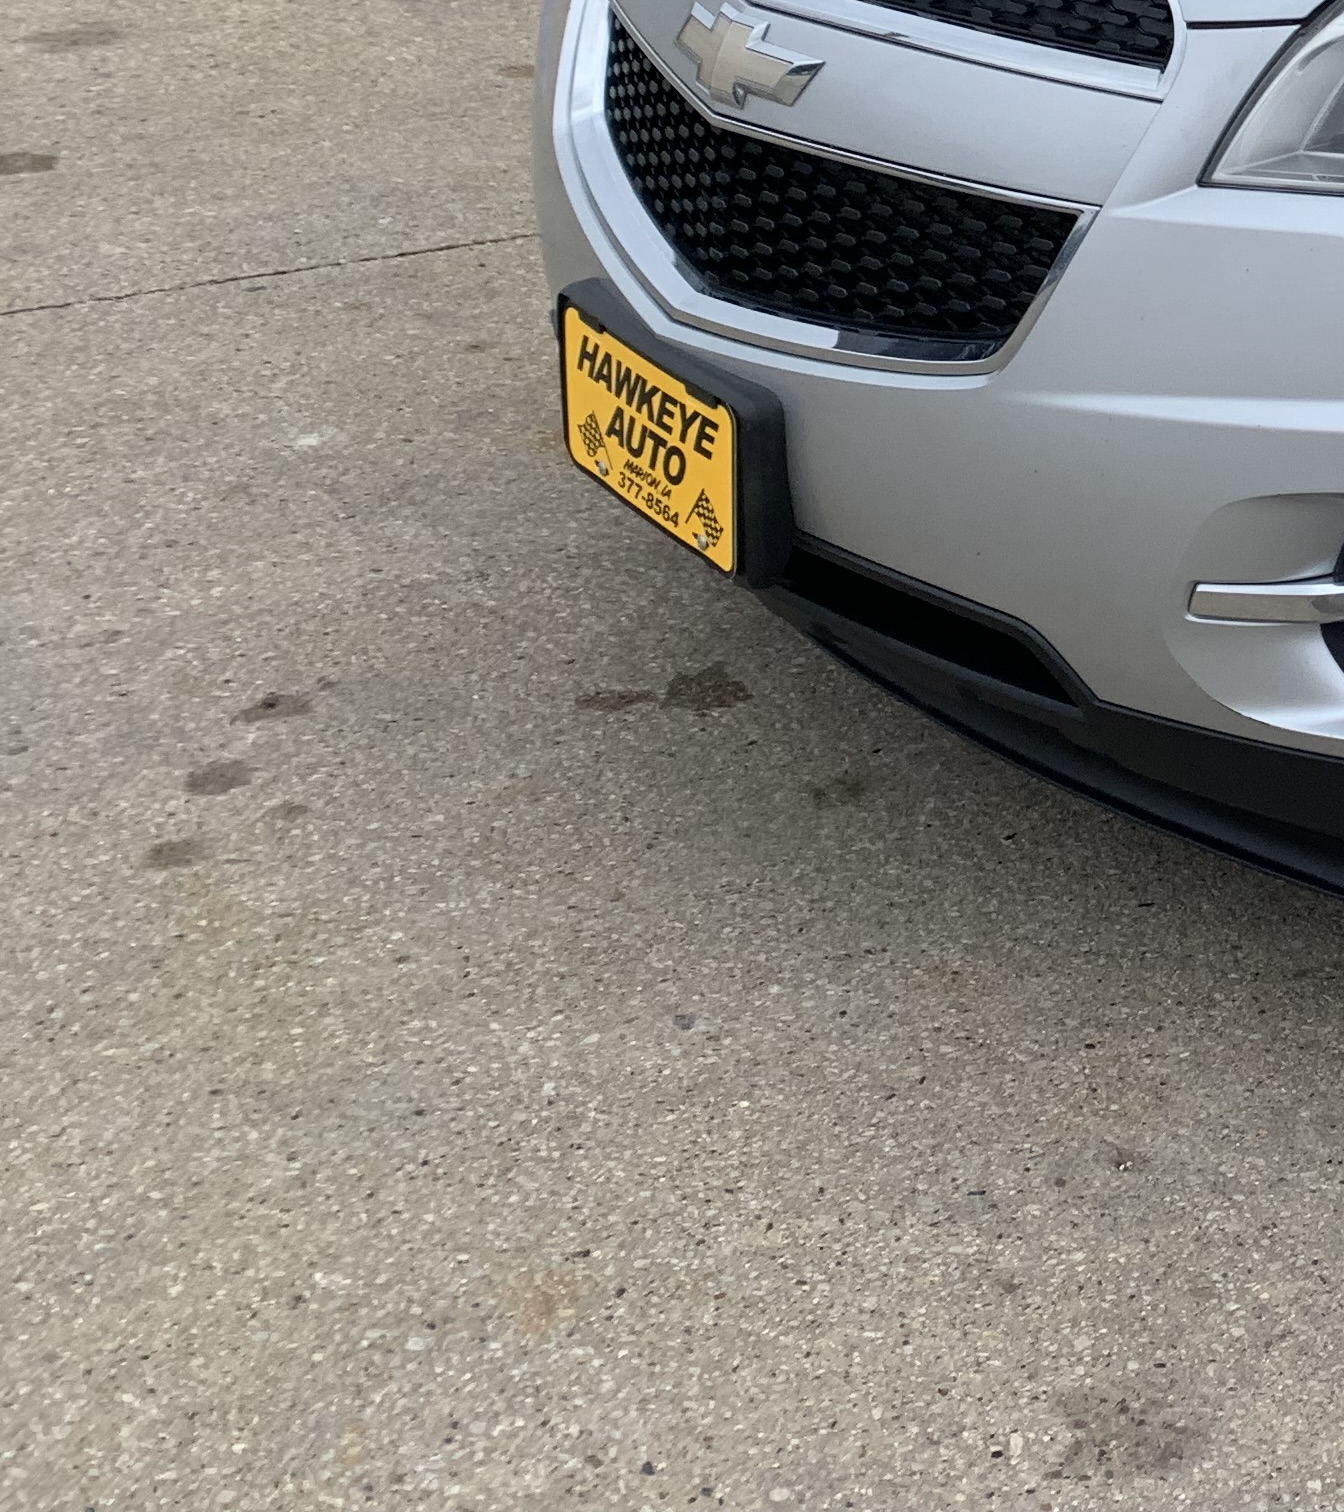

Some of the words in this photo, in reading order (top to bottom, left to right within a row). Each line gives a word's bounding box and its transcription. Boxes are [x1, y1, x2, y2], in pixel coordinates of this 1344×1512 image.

[577, 334, 719, 460] HAWKEYE
[605, 406, 686, 486] AUTO
[617, 472, 680, 528] 377-8564
